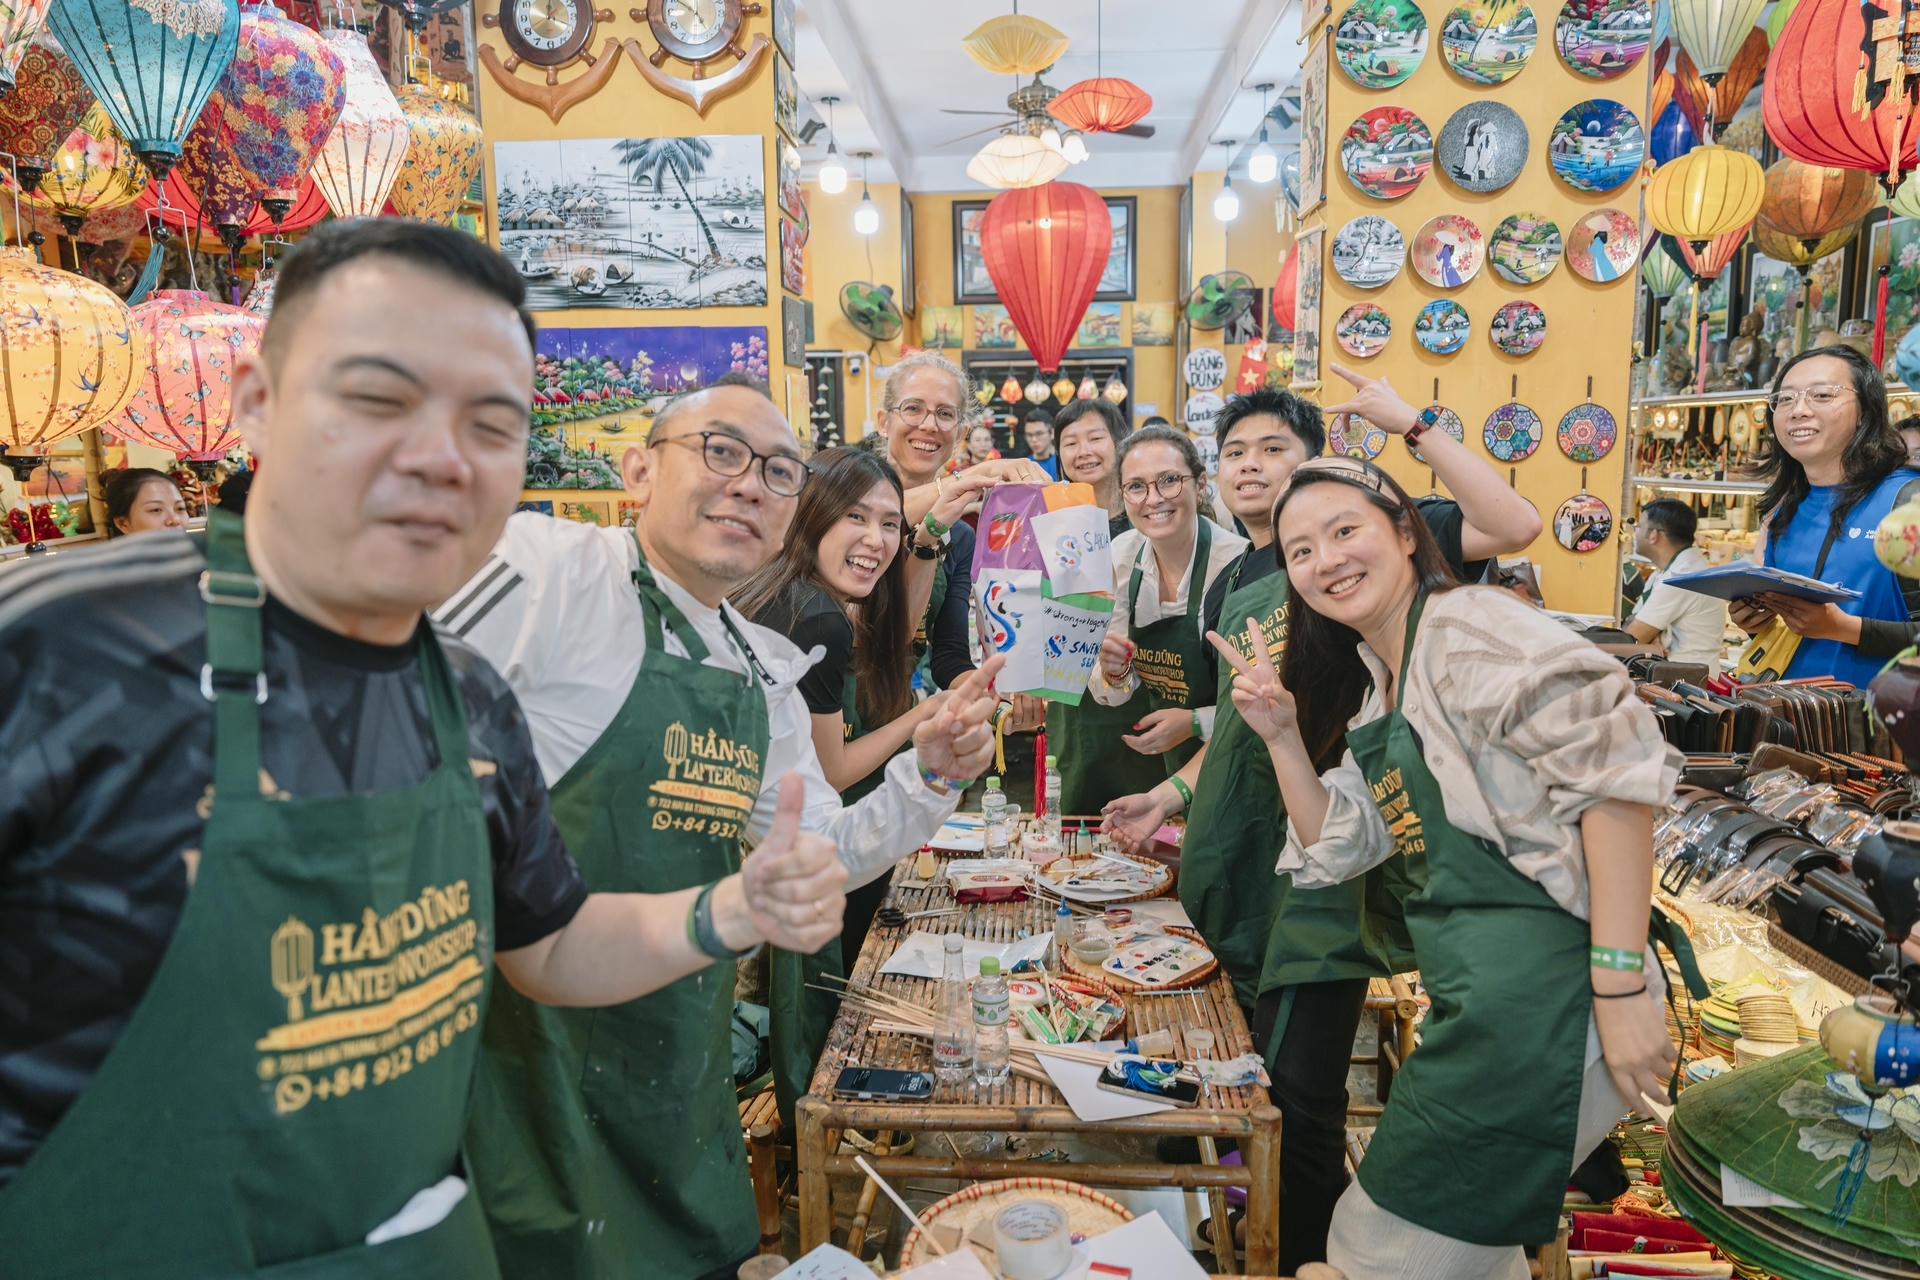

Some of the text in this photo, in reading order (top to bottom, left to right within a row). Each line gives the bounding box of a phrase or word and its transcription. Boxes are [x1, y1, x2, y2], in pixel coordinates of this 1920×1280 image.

[671, 816, 738, 839] +84 932
[313, 1062, 368, 1100] +84
